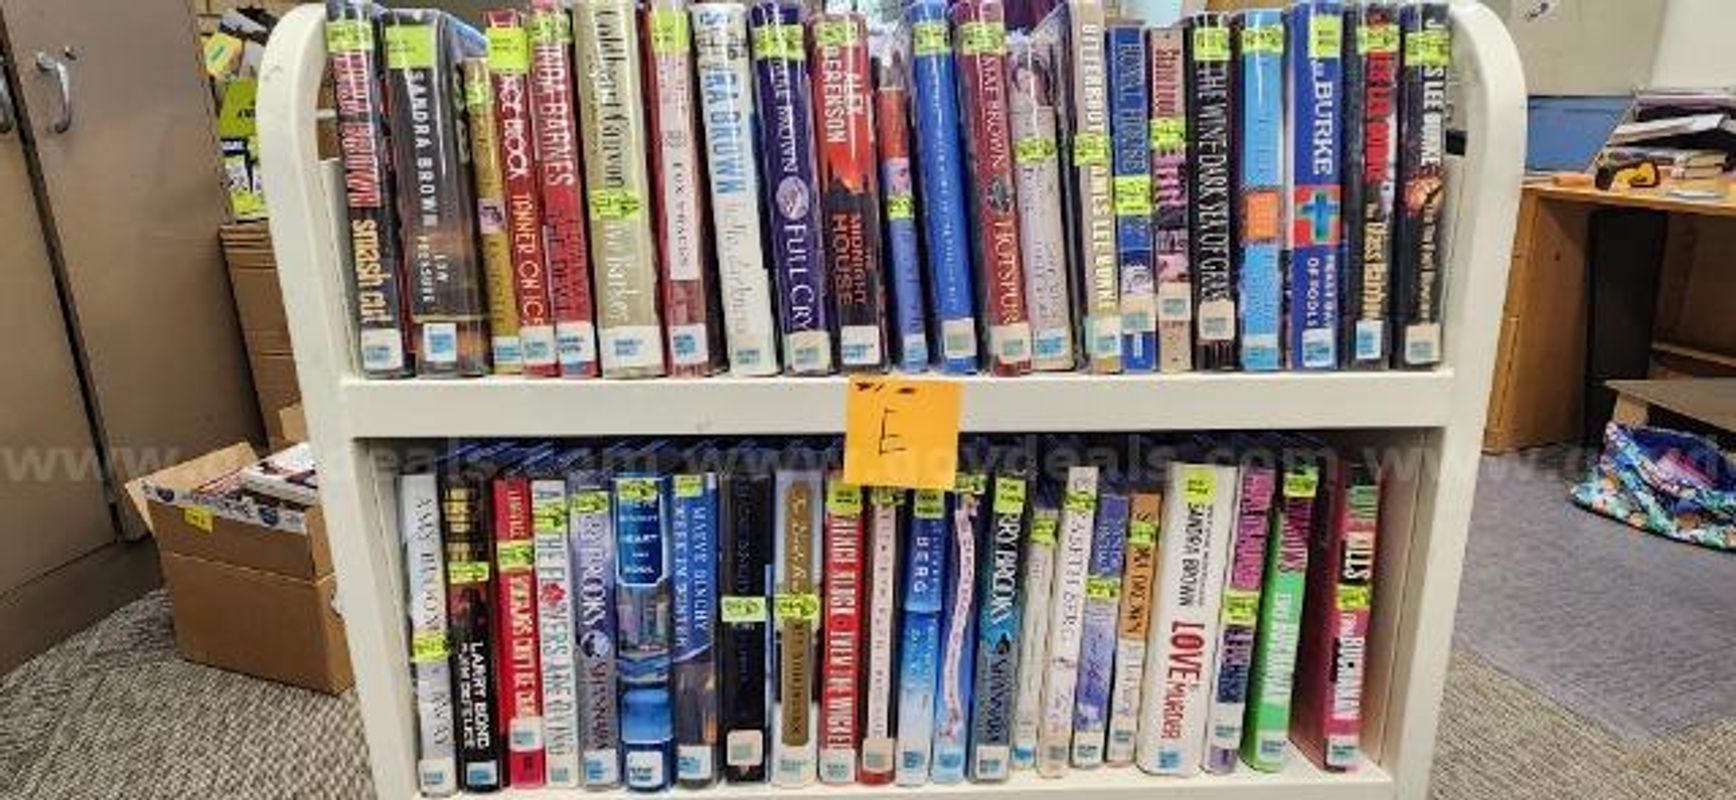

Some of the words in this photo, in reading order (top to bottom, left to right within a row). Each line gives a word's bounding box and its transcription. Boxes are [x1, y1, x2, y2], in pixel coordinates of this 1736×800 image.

[536, 44, 565, 92] INDA
[844, 72, 863, 114] ALEX
[1422, 80, 1444, 109] LEE
[407, 70, 433, 149] SANDRA
[985, 100, 1006, 169] BROWN
[1312, 80, 1335, 176] BURKE
[542, 102, 574, 186] BARNES
[711, 111, 745, 195] BROWN
[1420, 113, 1441, 166] BURKE
[417, 156, 438, 228] BROWN
[1090, 165, 1110, 216] AMES
[511, 192, 536, 254] TANNER
[783, 223, 808, 280] FULL
[352, 219, 389, 288] smash
[521, 259, 541, 289] ON
[832, 212, 851, 304] HOUSE
[1306, 257, 1321, 278] OF
[1306, 279, 1321, 327] FOOLS
[879, 407, 908, 456] E
[1184, 502, 1205, 554] SANDRA
[1344, 531, 1375, 580] KILLS
[913, 535, 929, 595] BERG
[1178, 558, 1200, 608] BROWN
[470, 642, 487, 698] LARRY
[1168, 620, 1206, 680] LOVE
[1332, 636, 1366, 720] BUCHANAN
[1160, 680, 1186, 740] MURDER
